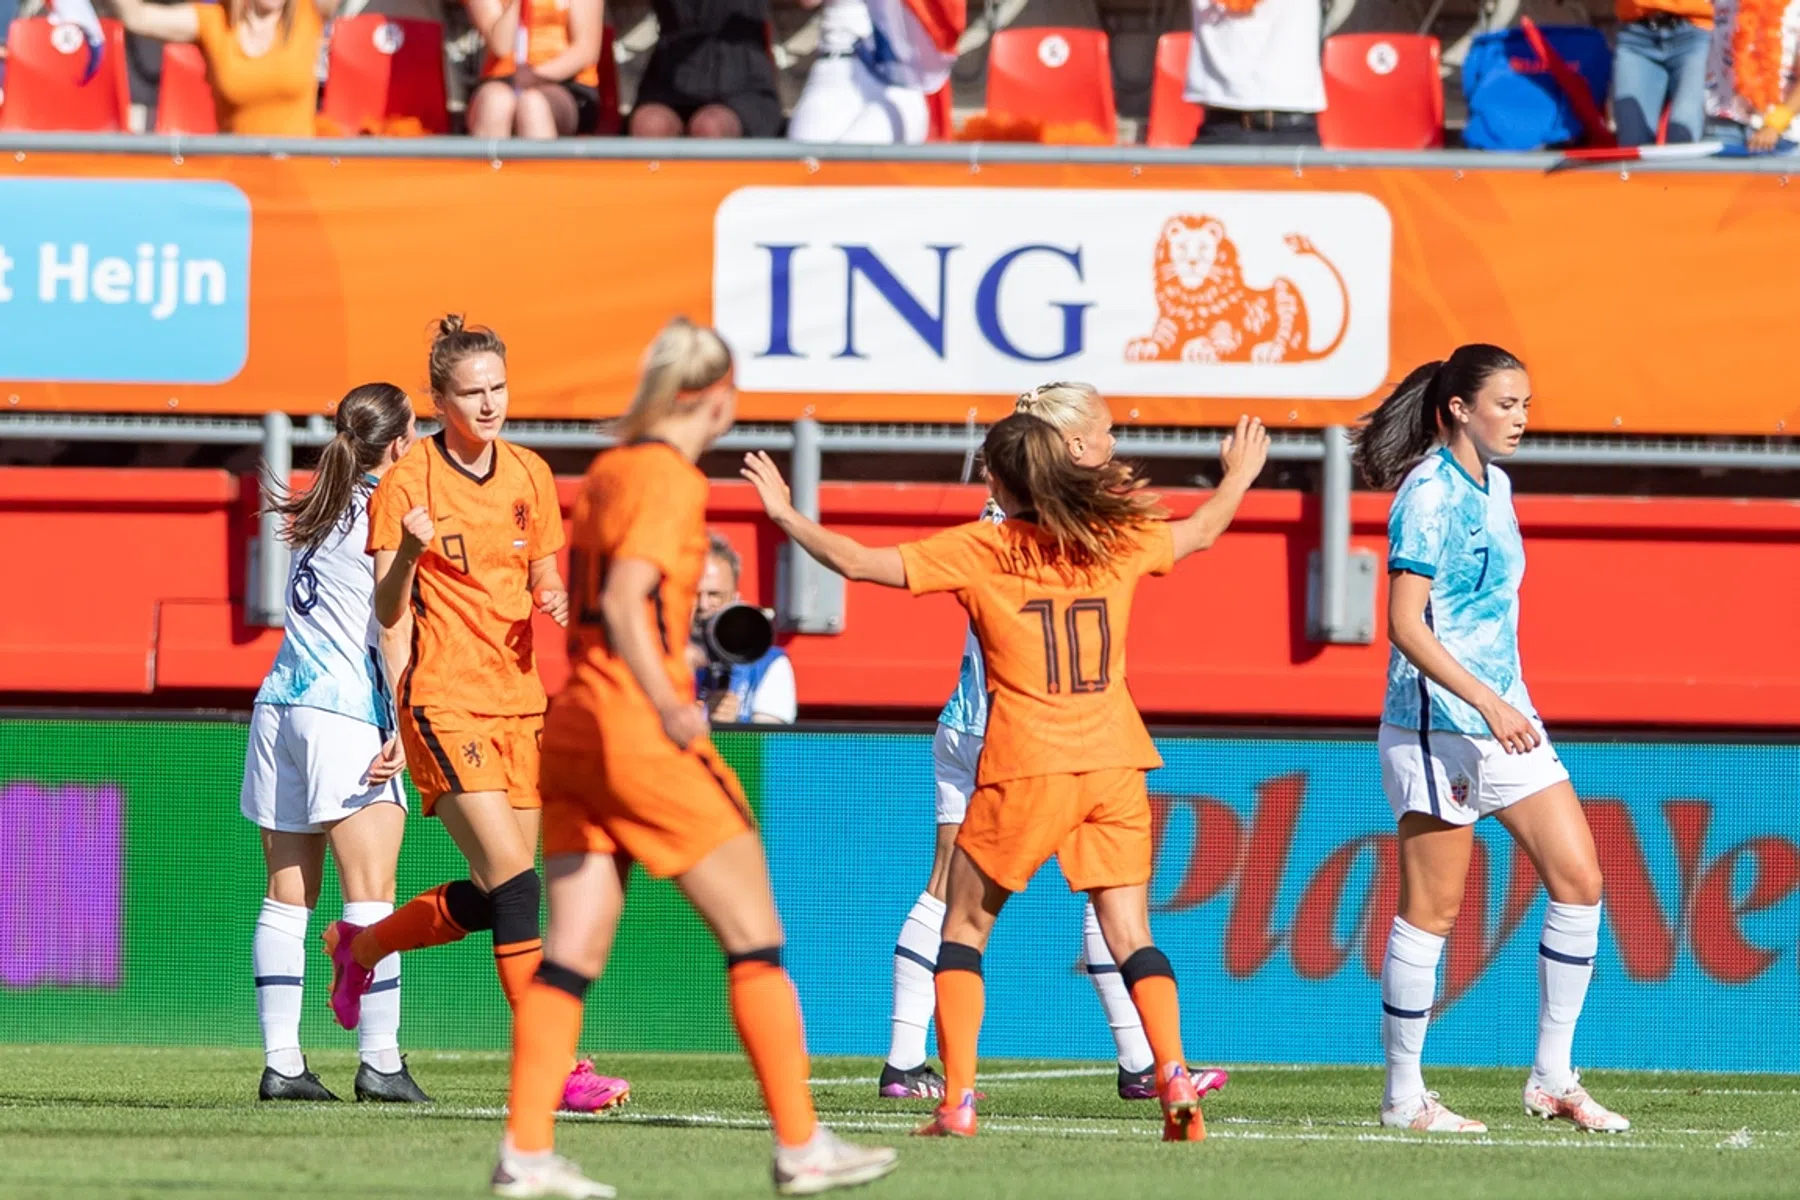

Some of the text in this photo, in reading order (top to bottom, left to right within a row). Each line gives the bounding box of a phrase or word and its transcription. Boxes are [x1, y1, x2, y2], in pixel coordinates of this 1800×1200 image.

[39, 243, 226, 320] Heijn
[753, 243, 1098, 363] ING
[292, 541, 319, 616] 6
[441, 533, 470, 576] 9
[1473, 547, 1489, 592] 7
[1018, 598, 1111, 695] 10
